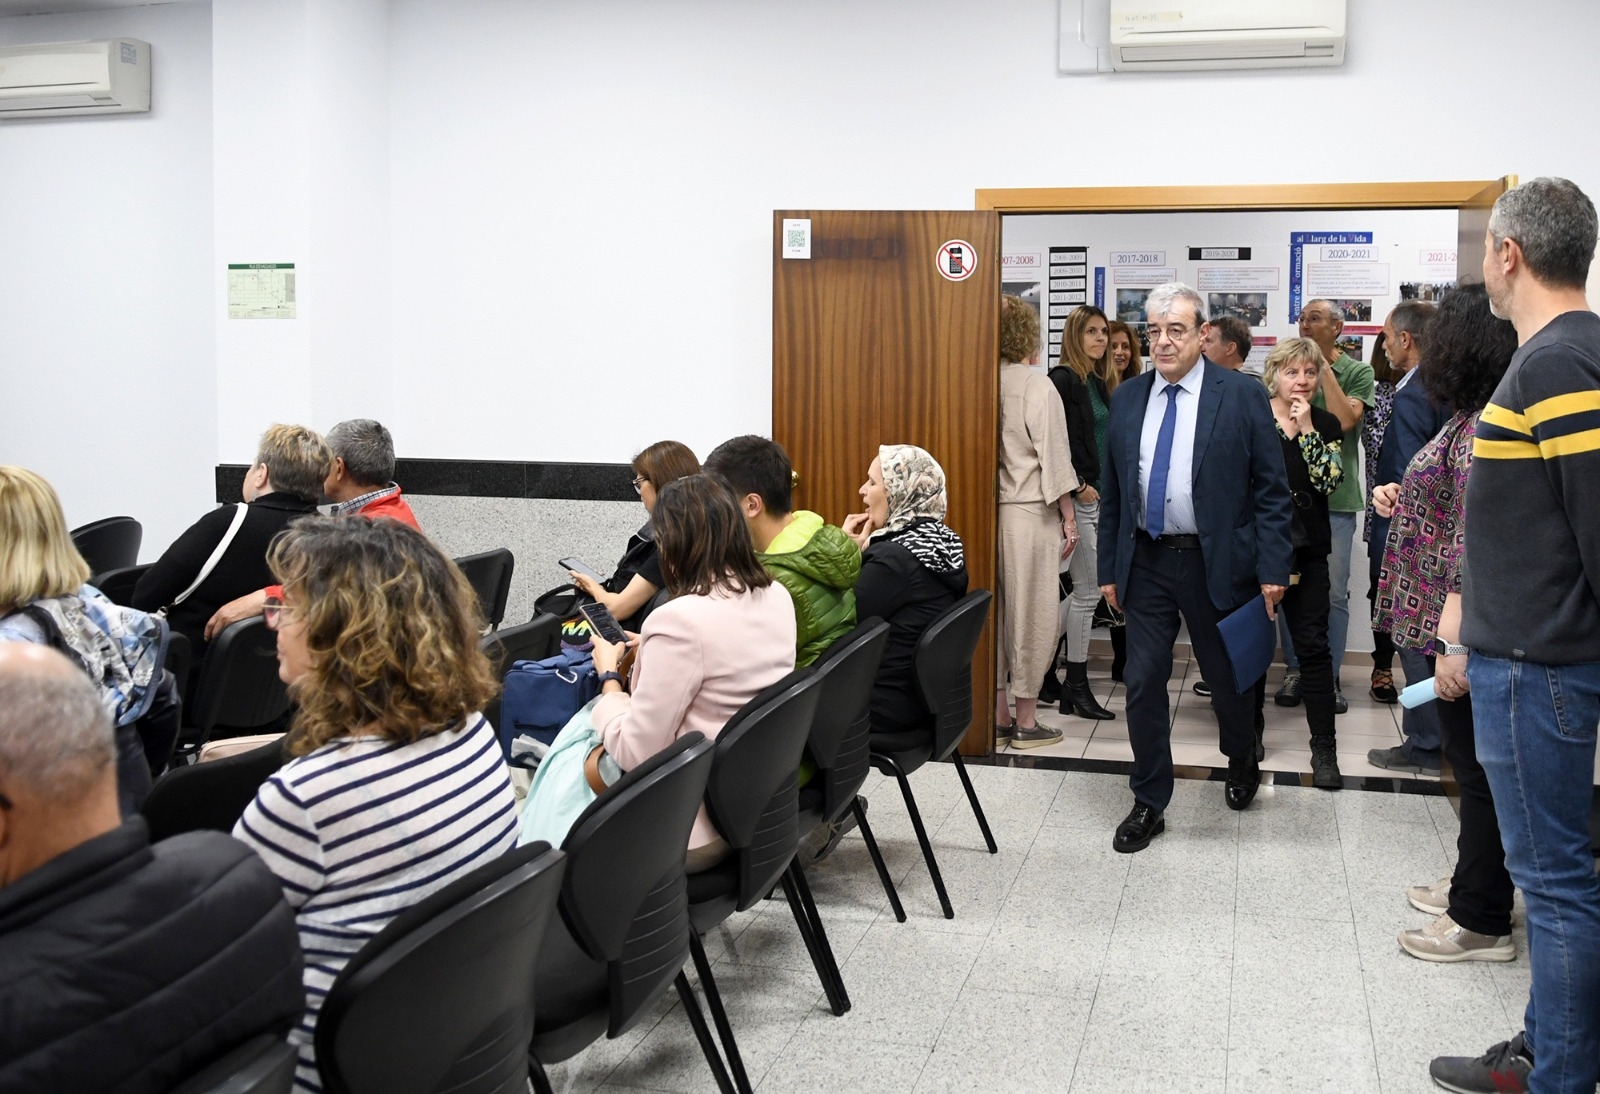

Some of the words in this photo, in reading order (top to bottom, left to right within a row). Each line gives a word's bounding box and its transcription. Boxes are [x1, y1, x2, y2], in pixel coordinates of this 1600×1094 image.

[1296, 234, 1304, 243] al
[1328, 234, 1338, 243] de
[1339, 234, 1347, 243] la
[1348, 233, 1367, 243] Vida
[1117, 254, 1159, 264] 2017-2018
[1204, 250, 1236, 258] 2019-2020
[1328, 249, 1370, 259] 2020-2021
[1427, 252, 1457, 262] 2021-2
[1292, 284, 1301, 294] de
[1293, 295, 1301, 316] entre
